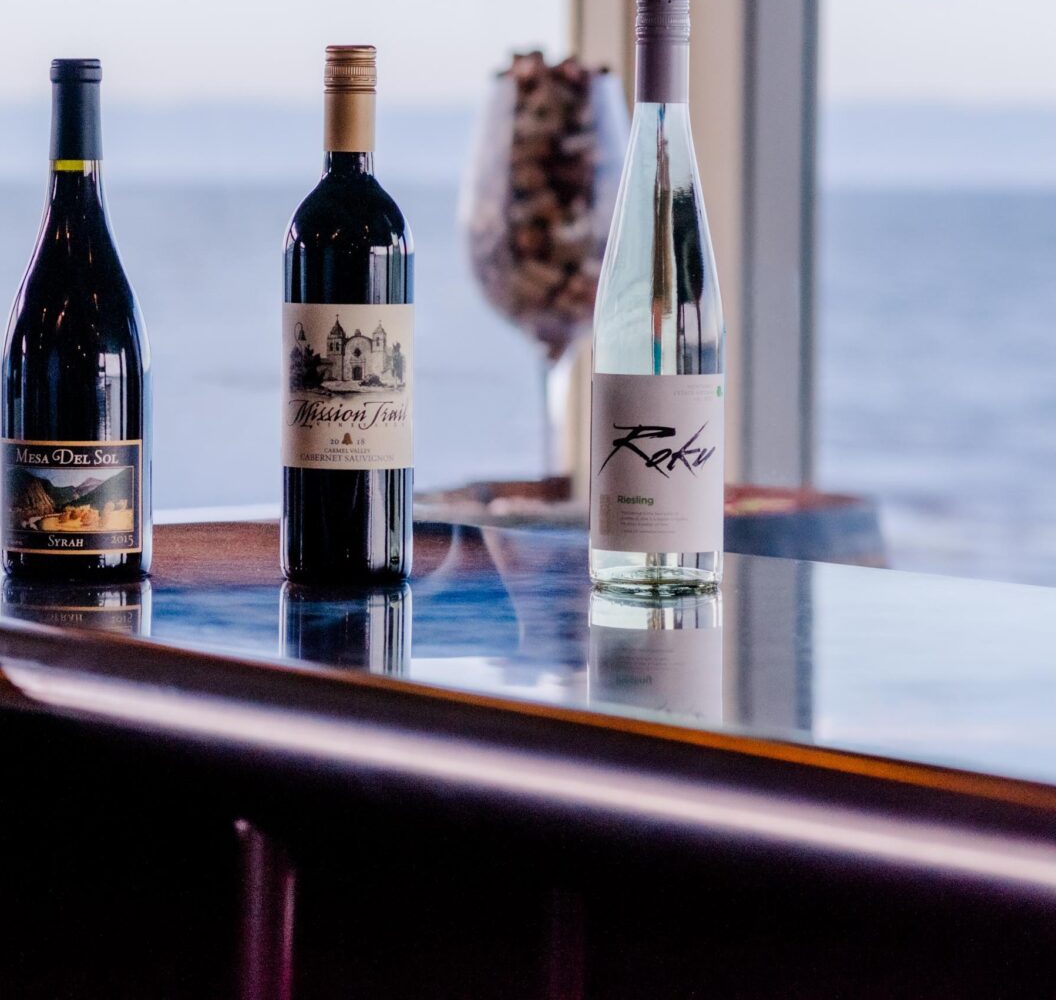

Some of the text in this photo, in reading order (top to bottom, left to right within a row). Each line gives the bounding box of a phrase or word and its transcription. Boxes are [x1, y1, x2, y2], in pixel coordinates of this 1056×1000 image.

[288, 398, 407, 430] Mission Trail
[300, 453, 395, 463] CABERNET SAUVIGNON
[617, 495, 654, 506] Riesling
[111, 535, 134, 546] 2015
